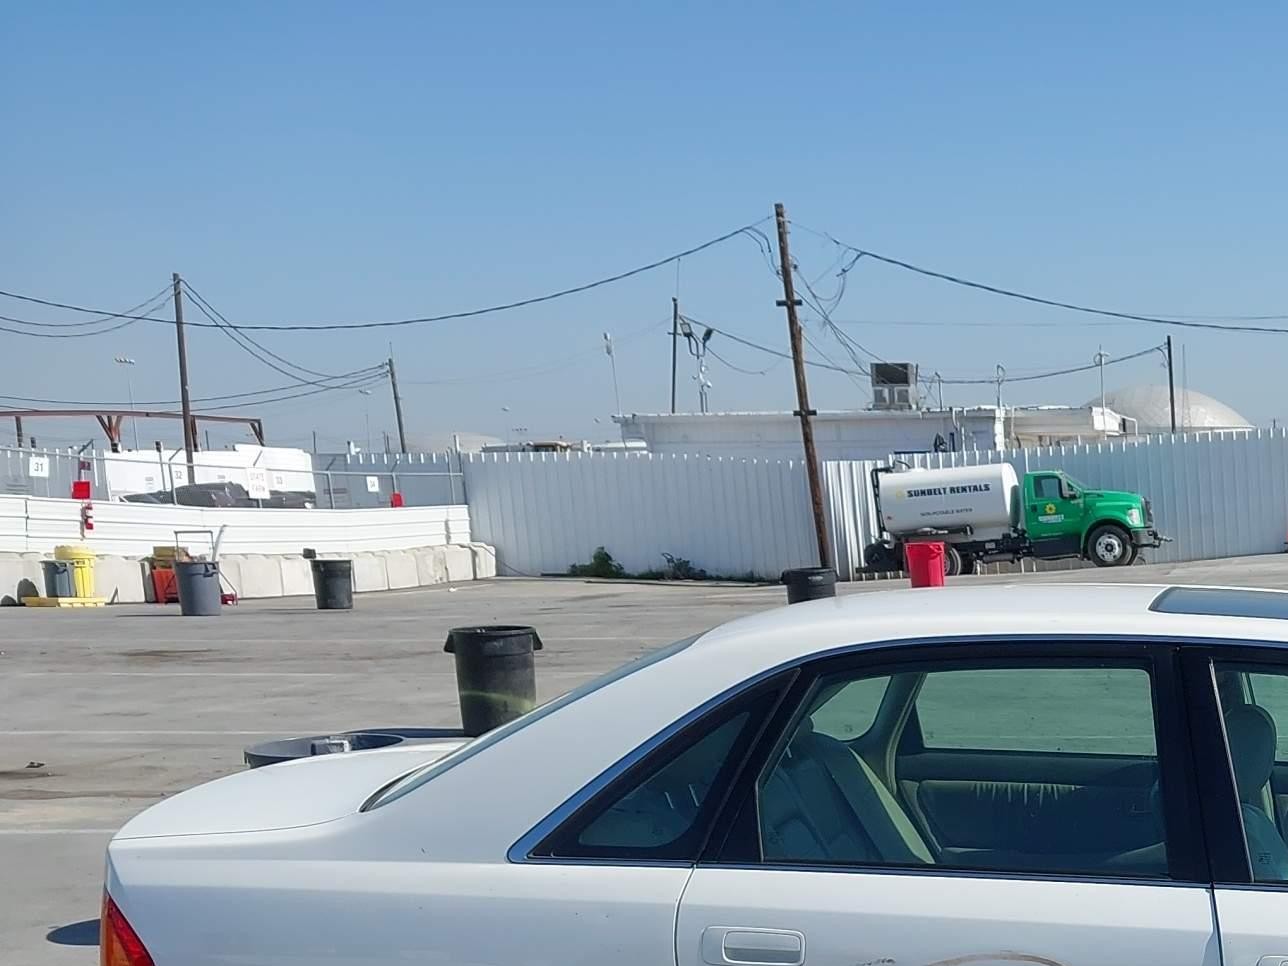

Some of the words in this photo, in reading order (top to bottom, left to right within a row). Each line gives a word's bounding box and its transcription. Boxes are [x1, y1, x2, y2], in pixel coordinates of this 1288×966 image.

[34, 462, 43, 472] 31
[907, 487, 947, 497] SUNBELT
[949, 484, 990, 494] RENTALS
